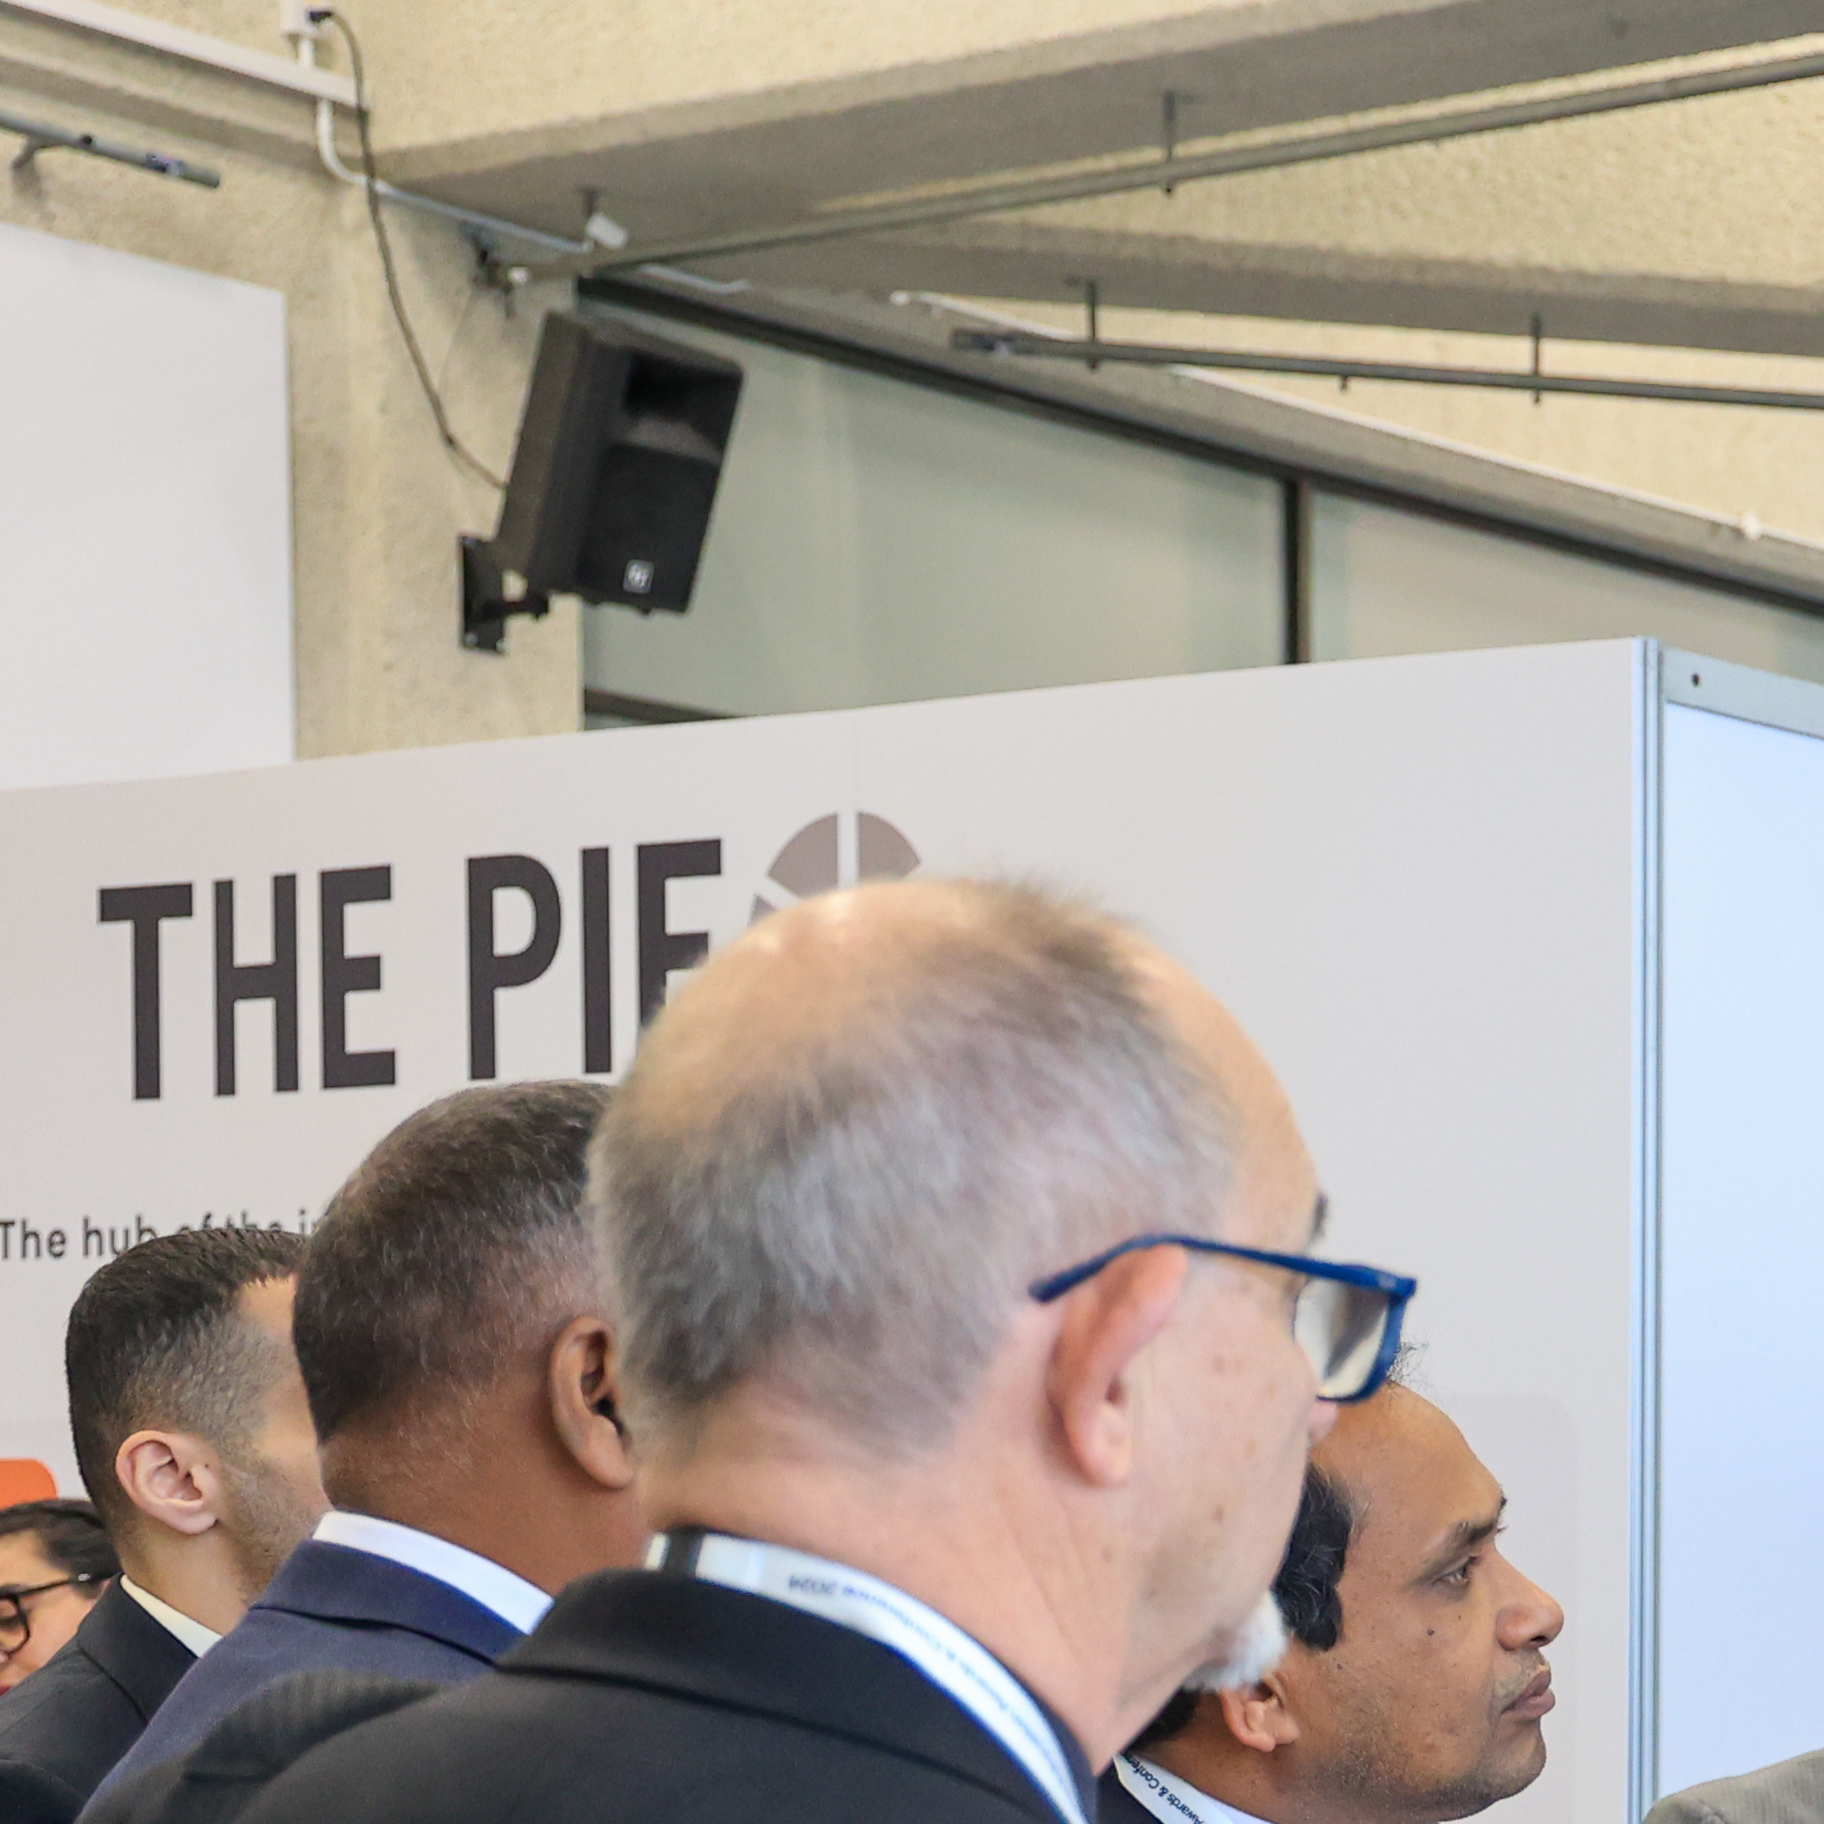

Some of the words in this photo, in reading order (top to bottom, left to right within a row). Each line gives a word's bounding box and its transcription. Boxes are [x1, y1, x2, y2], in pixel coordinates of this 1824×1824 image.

[98, 864, 397, 1101] THE
[0, 1217, 67, 1260] The
[1156, 1785, 1169, 1797] &
